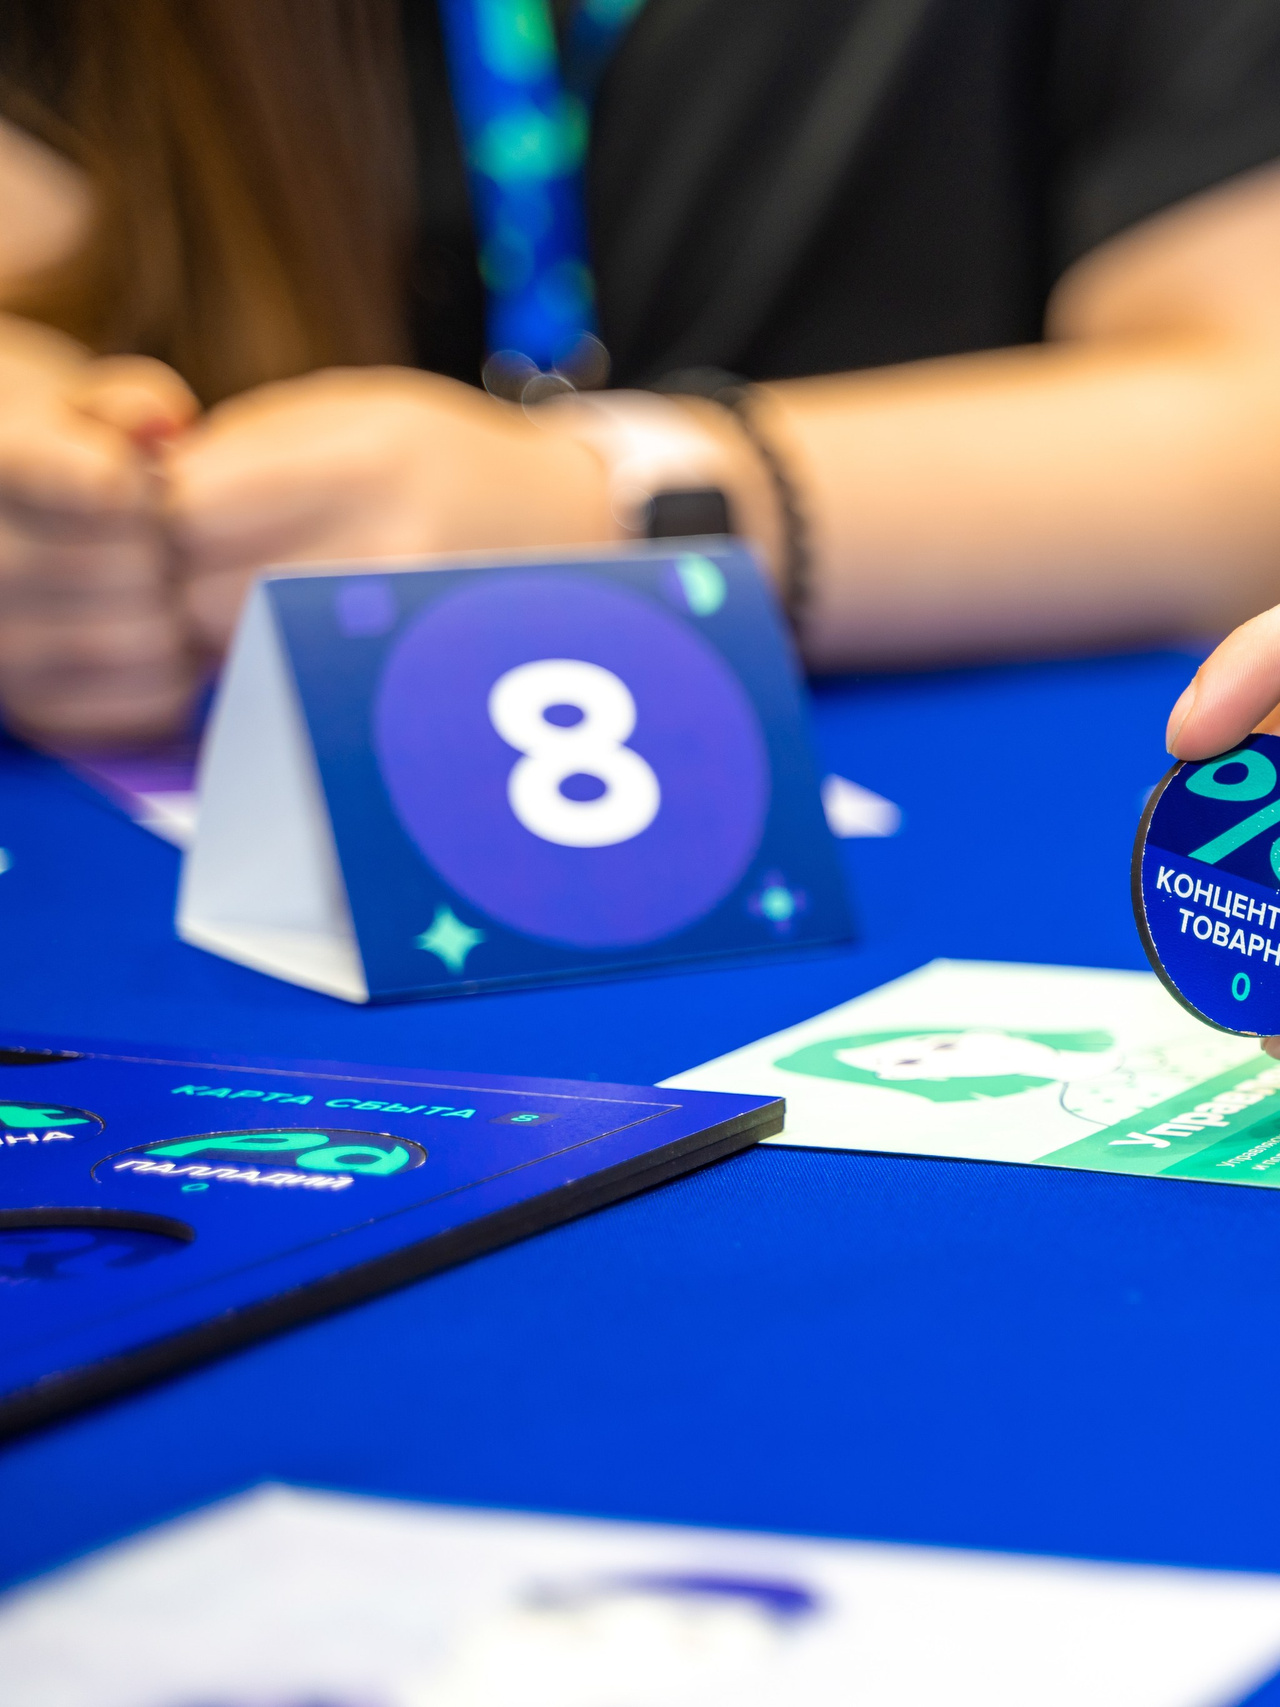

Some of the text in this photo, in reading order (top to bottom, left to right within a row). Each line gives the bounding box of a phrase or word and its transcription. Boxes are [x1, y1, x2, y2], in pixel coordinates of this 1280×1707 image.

[487, 657, 661, 848] 8
[1231, 972, 1250, 1001] 0
[170, 1084, 314, 1105] КАРТА
[325, 1098, 476, 1119] СБЫТА
[0, 1131, 75, 1146] НА
[144, 1132, 410, 1176] Pd
[113, 1159, 354, 1190] ПАЛЛАДИЙ
